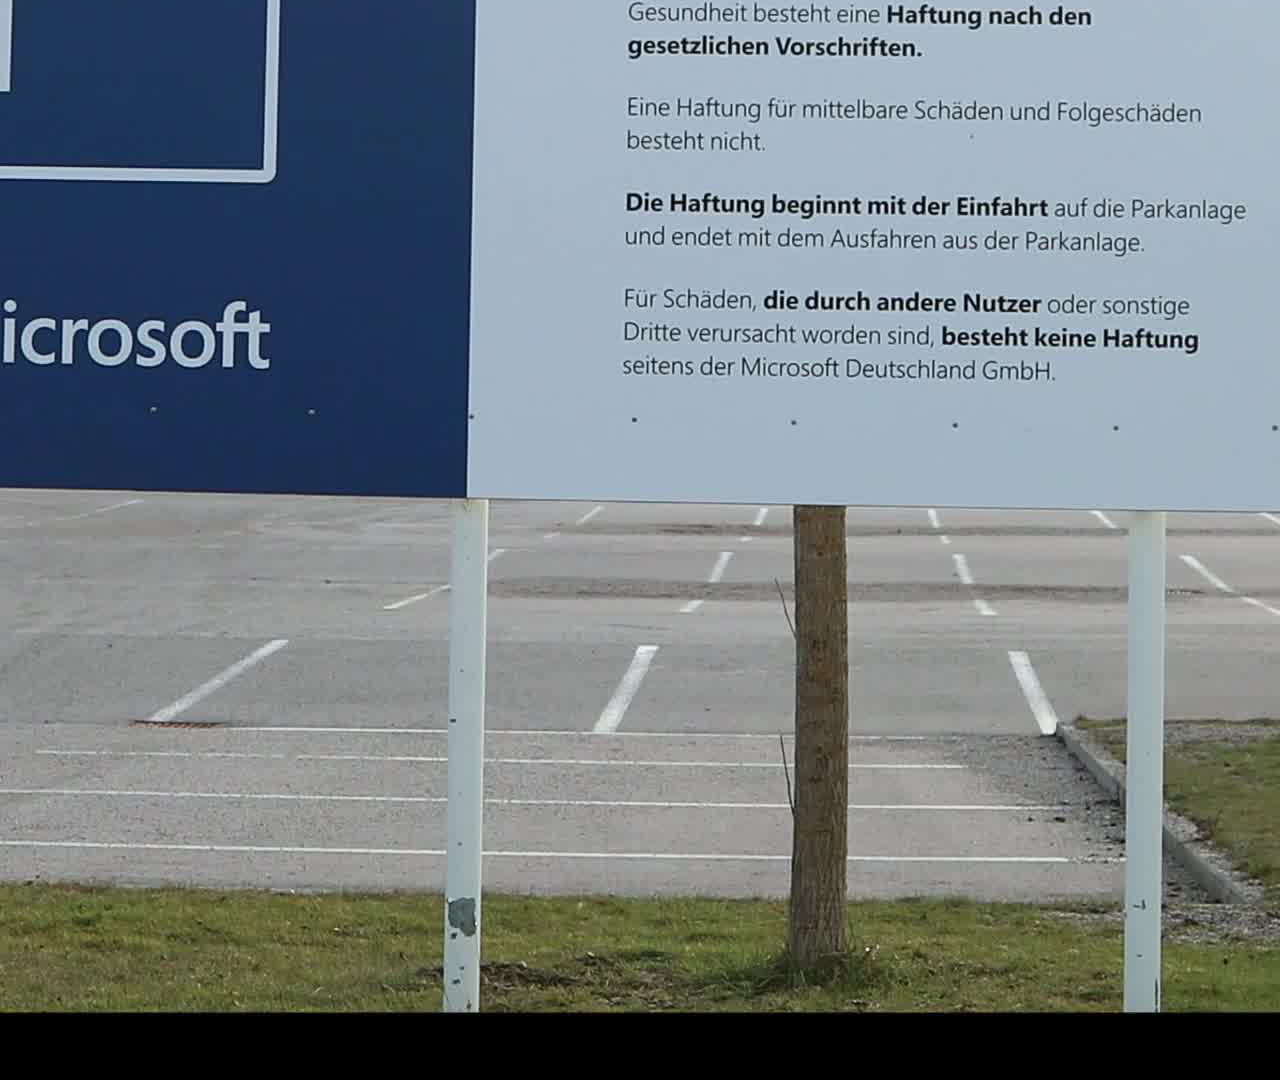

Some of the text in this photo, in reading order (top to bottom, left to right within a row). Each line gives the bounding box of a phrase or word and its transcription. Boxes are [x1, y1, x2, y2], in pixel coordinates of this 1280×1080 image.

[628, 1, 1092, 31] Gesundheit besteht eine Haftung nach den
[627, 34, 923, 60] gesetzlichen Vorschriften.
[627, 96, 1202, 128] Eine Haftung für mittelbare Schäden und Folgeschäden
[626, 128, 766, 152] besteht nicht.
[625, 191, 1247, 225] Die Haftung beginnt mit der Einfahrt auf die Parkanlage
[625, 225, 1145, 258] und endet mit dem Ausfahren aus der Parkanlage.
[624, 287, 1191, 321] Für Schäden, die durch andere Nutzer oder sonstige
[623, 321, 1199, 355] Dritte verursacht worden sind, besteht keine Haftung
[622, 354, 1056, 382] seitens der Microsoft Deutschland GmbH.
